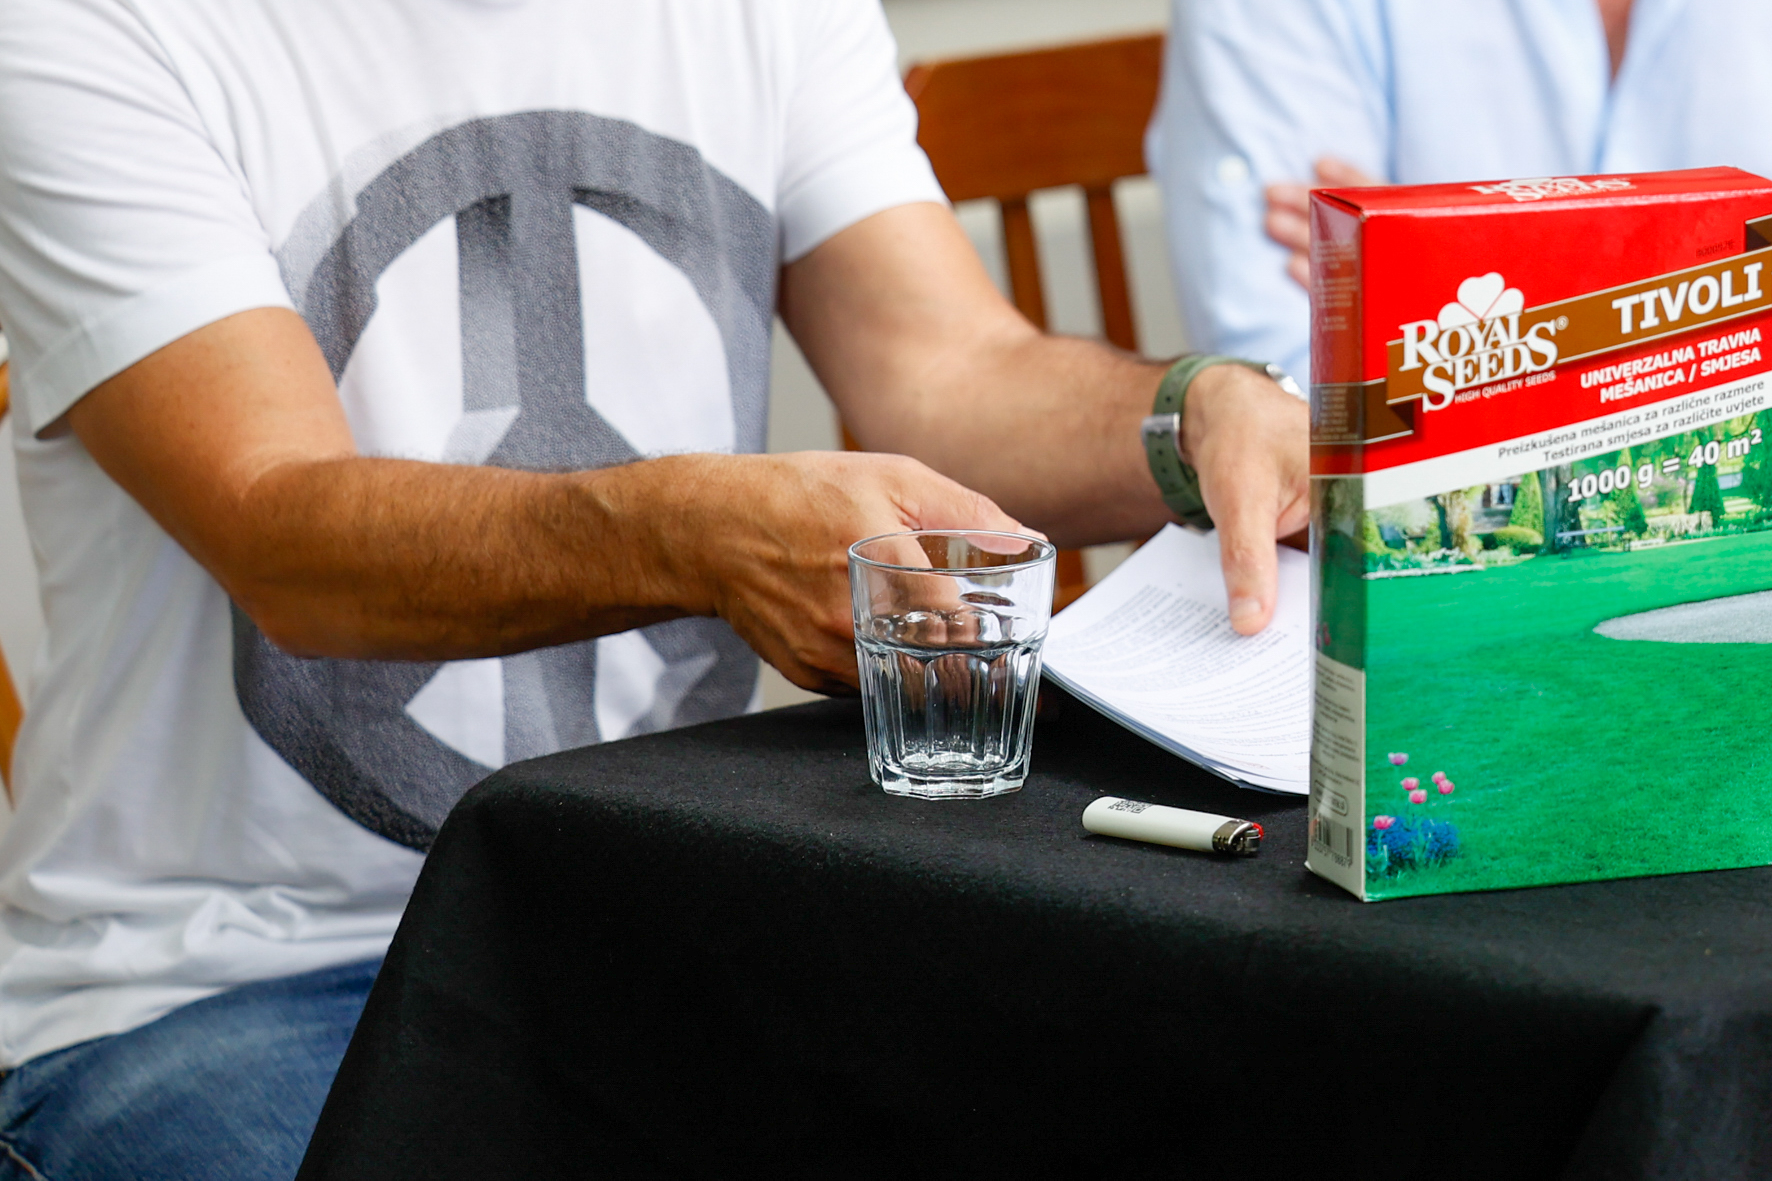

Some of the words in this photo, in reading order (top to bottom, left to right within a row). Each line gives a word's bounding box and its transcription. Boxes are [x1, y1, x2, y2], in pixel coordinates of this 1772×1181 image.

[1611, 261, 1763, 335] TIVOLI
[1398, 312, 1529, 372] ROYAL
[1580, 345, 1695, 389] UNIVERZALNA
[1697, 327, 1762, 358] TRAVNA
[1454, 388, 1481, 404] HIGH
[1482, 377, 1524, 399] QUALITY
[1524, 370, 1557, 388] SEEDS
[1600, 367, 1686, 404] MEŠANICA
[1700, 347, 1762, 377] SMJESA
[1498, 430, 1577, 458] Preizkušena
[1581, 414, 1640, 439] mešanica
[1644, 409, 1659, 421] za
[1662, 395, 1710, 418] različne
[1714, 380, 1765, 404] razmere
[1543, 438, 1603, 462] Testirana
[1607, 427, 1651, 450] smjesa
[1655, 421, 1669, 434] za
[1673, 406, 1722, 431] različite
[1725, 393, 1765, 419] uvjete
[1567, 465, 1631, 503] 1000
[1637, 463, 1654, 489] g
[1662, 456, 1681, 474] =
[1687, 440, 1721, 469] 40
